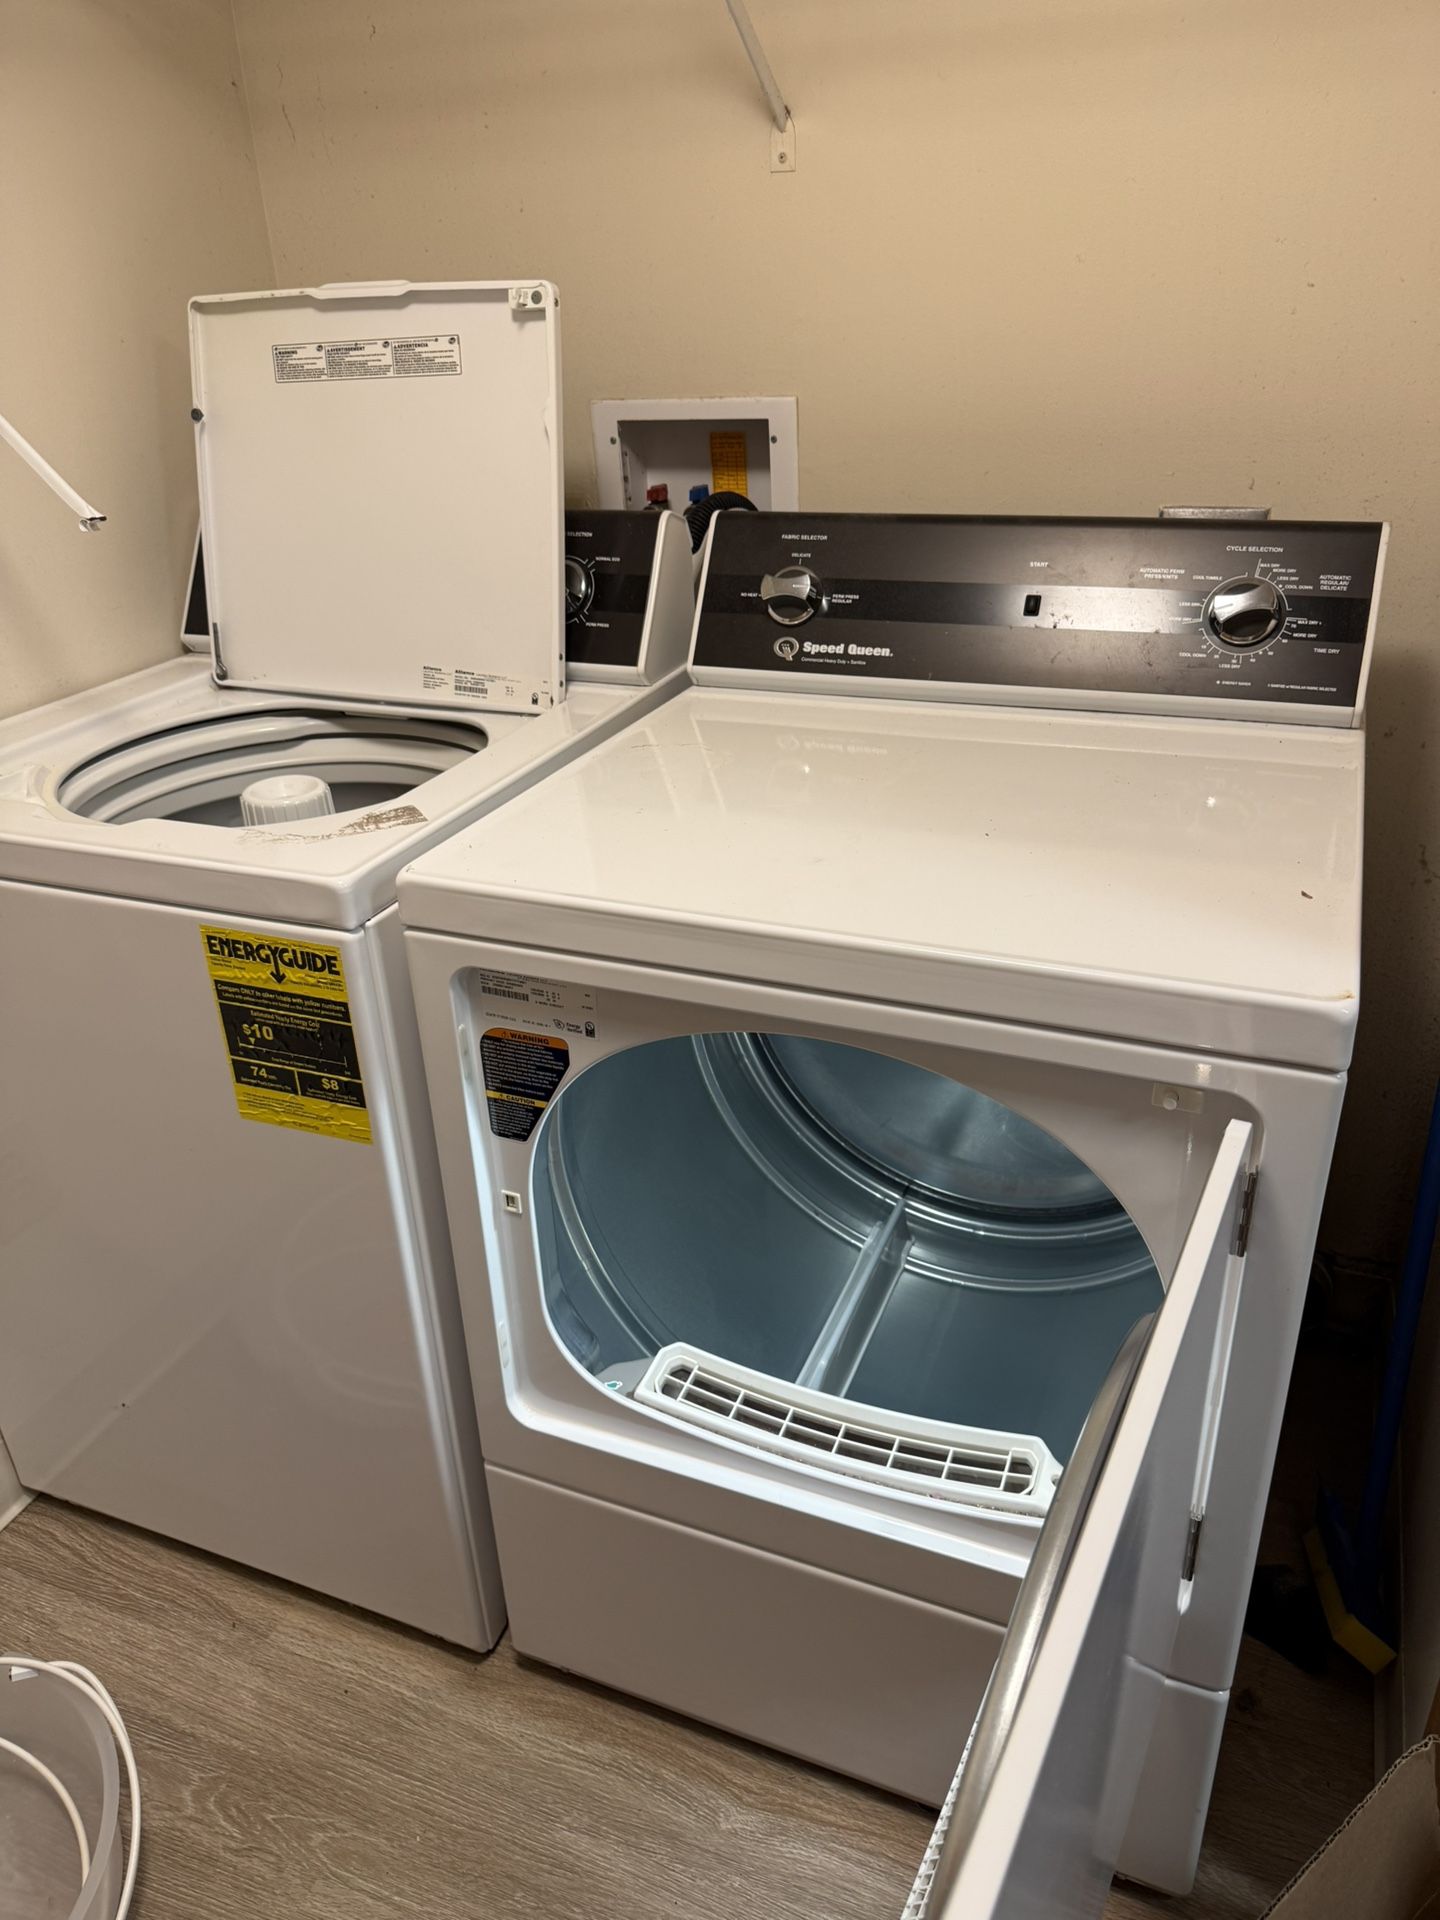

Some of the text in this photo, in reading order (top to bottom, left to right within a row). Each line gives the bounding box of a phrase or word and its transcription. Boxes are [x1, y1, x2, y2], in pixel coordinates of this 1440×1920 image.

[802, 641, 845, 654] Speed
[206, 934, 341, 976] ENERGYGUIDE
[217, 984, 240, 993] Compare
[240, 987, 256, 996] ONLY
[304, 1000, 321, 1008] yellow
[290, 1016, 308, 1026] Energy
[241, 1023, 274, 1040] $10
[510, 1032, 550, 1045] WARNING
[250, 1066, 268, 1078] 74
[321, 1078, 340, 1091] $8
[505, 1095, 536, 1106] CAUTION
